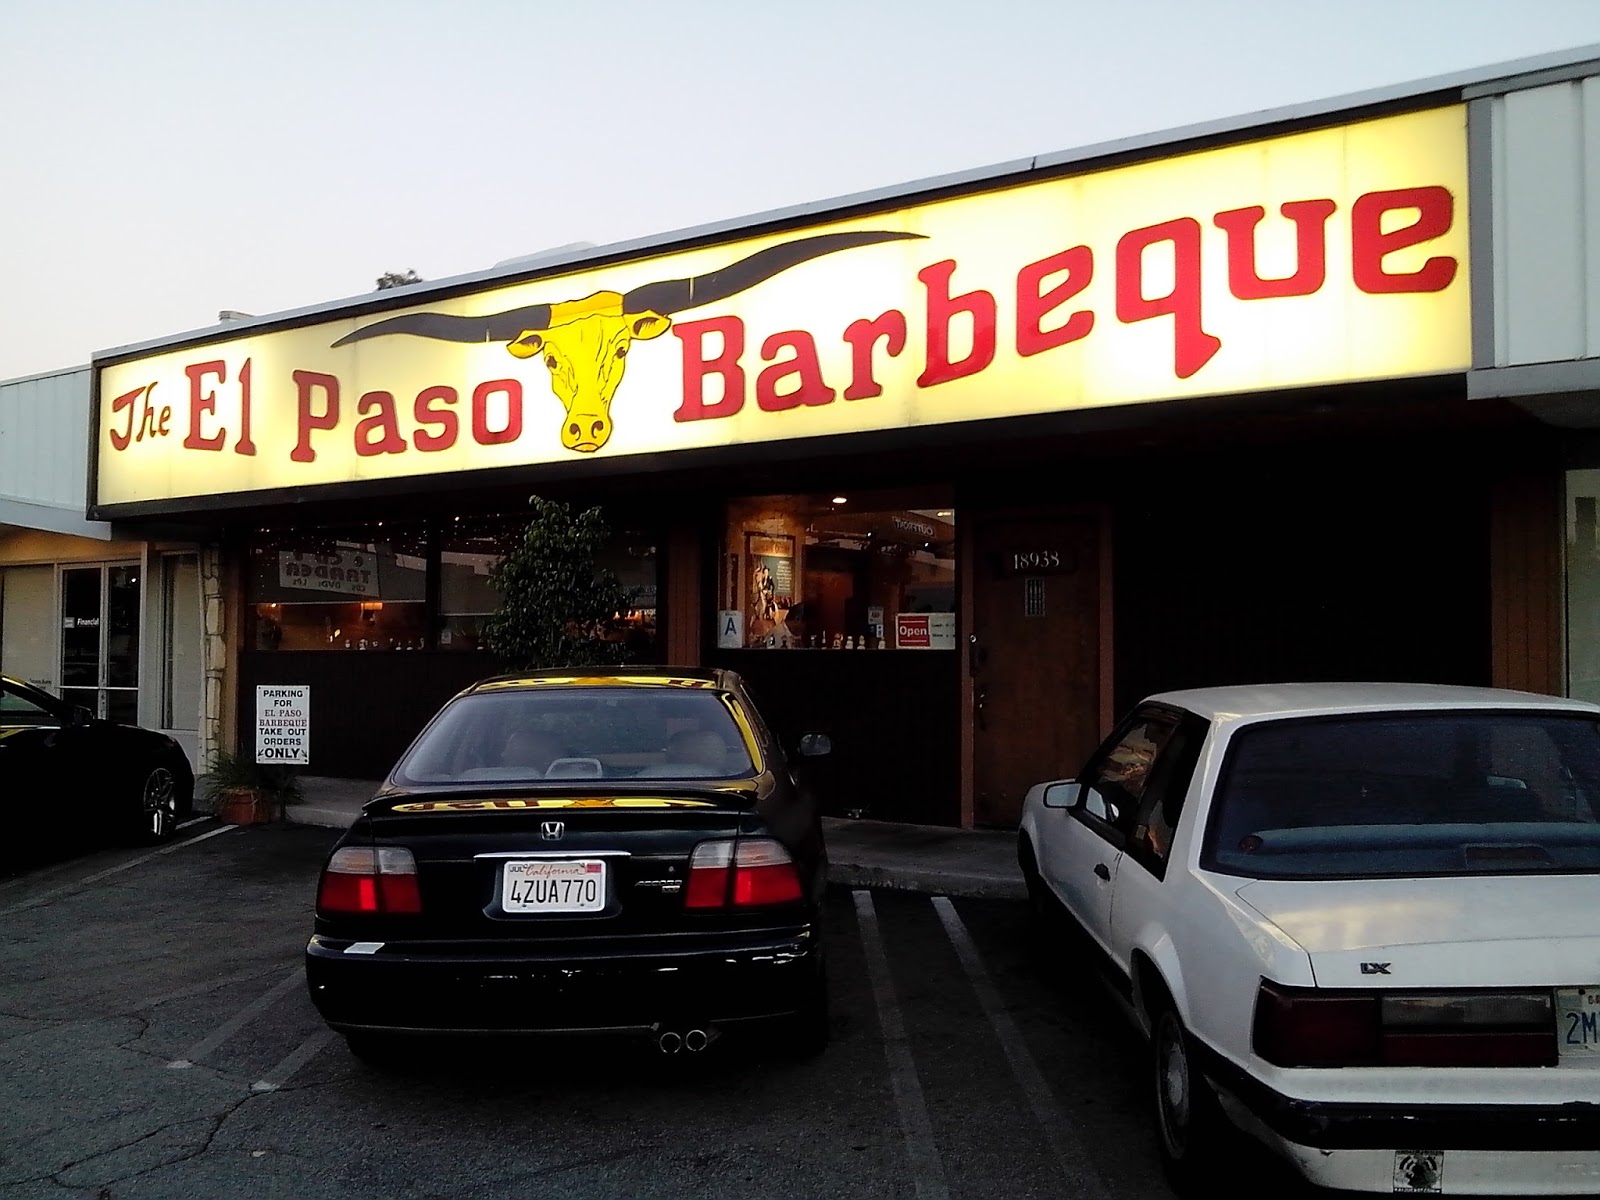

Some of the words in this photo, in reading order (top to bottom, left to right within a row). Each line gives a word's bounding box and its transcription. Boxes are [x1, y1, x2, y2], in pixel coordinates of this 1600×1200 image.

[110, 381, 170, 451] The
[292, 369, 523, 463] Paso
[672, 185, 1459, 423] Barbeque
[1014, 550, 1060, 570] 18938
[77, 617, 99, 626] Financial
[725, 617, 737, 635] A
[899, 625, 928, 638] Open
[263, 689, 304, 698] PARKING
[274, 699, 292, 707] FOR
[264, 709, 276, 717] EL
[279, 709, 302, 717] PASO
[259, 719, 308, 727] BARBEQUE
[259, 727, 283, 736] TAKE
[287, 728, 307, 736] OUT
[263, 737, 302, 746] ORDERS
[264, 747, 300, 759] ONLY
[525, 864, 586, 879] California
[510, 879, 597, 904] 4ZUA770
[1360, 962, 1392, 975] LX
